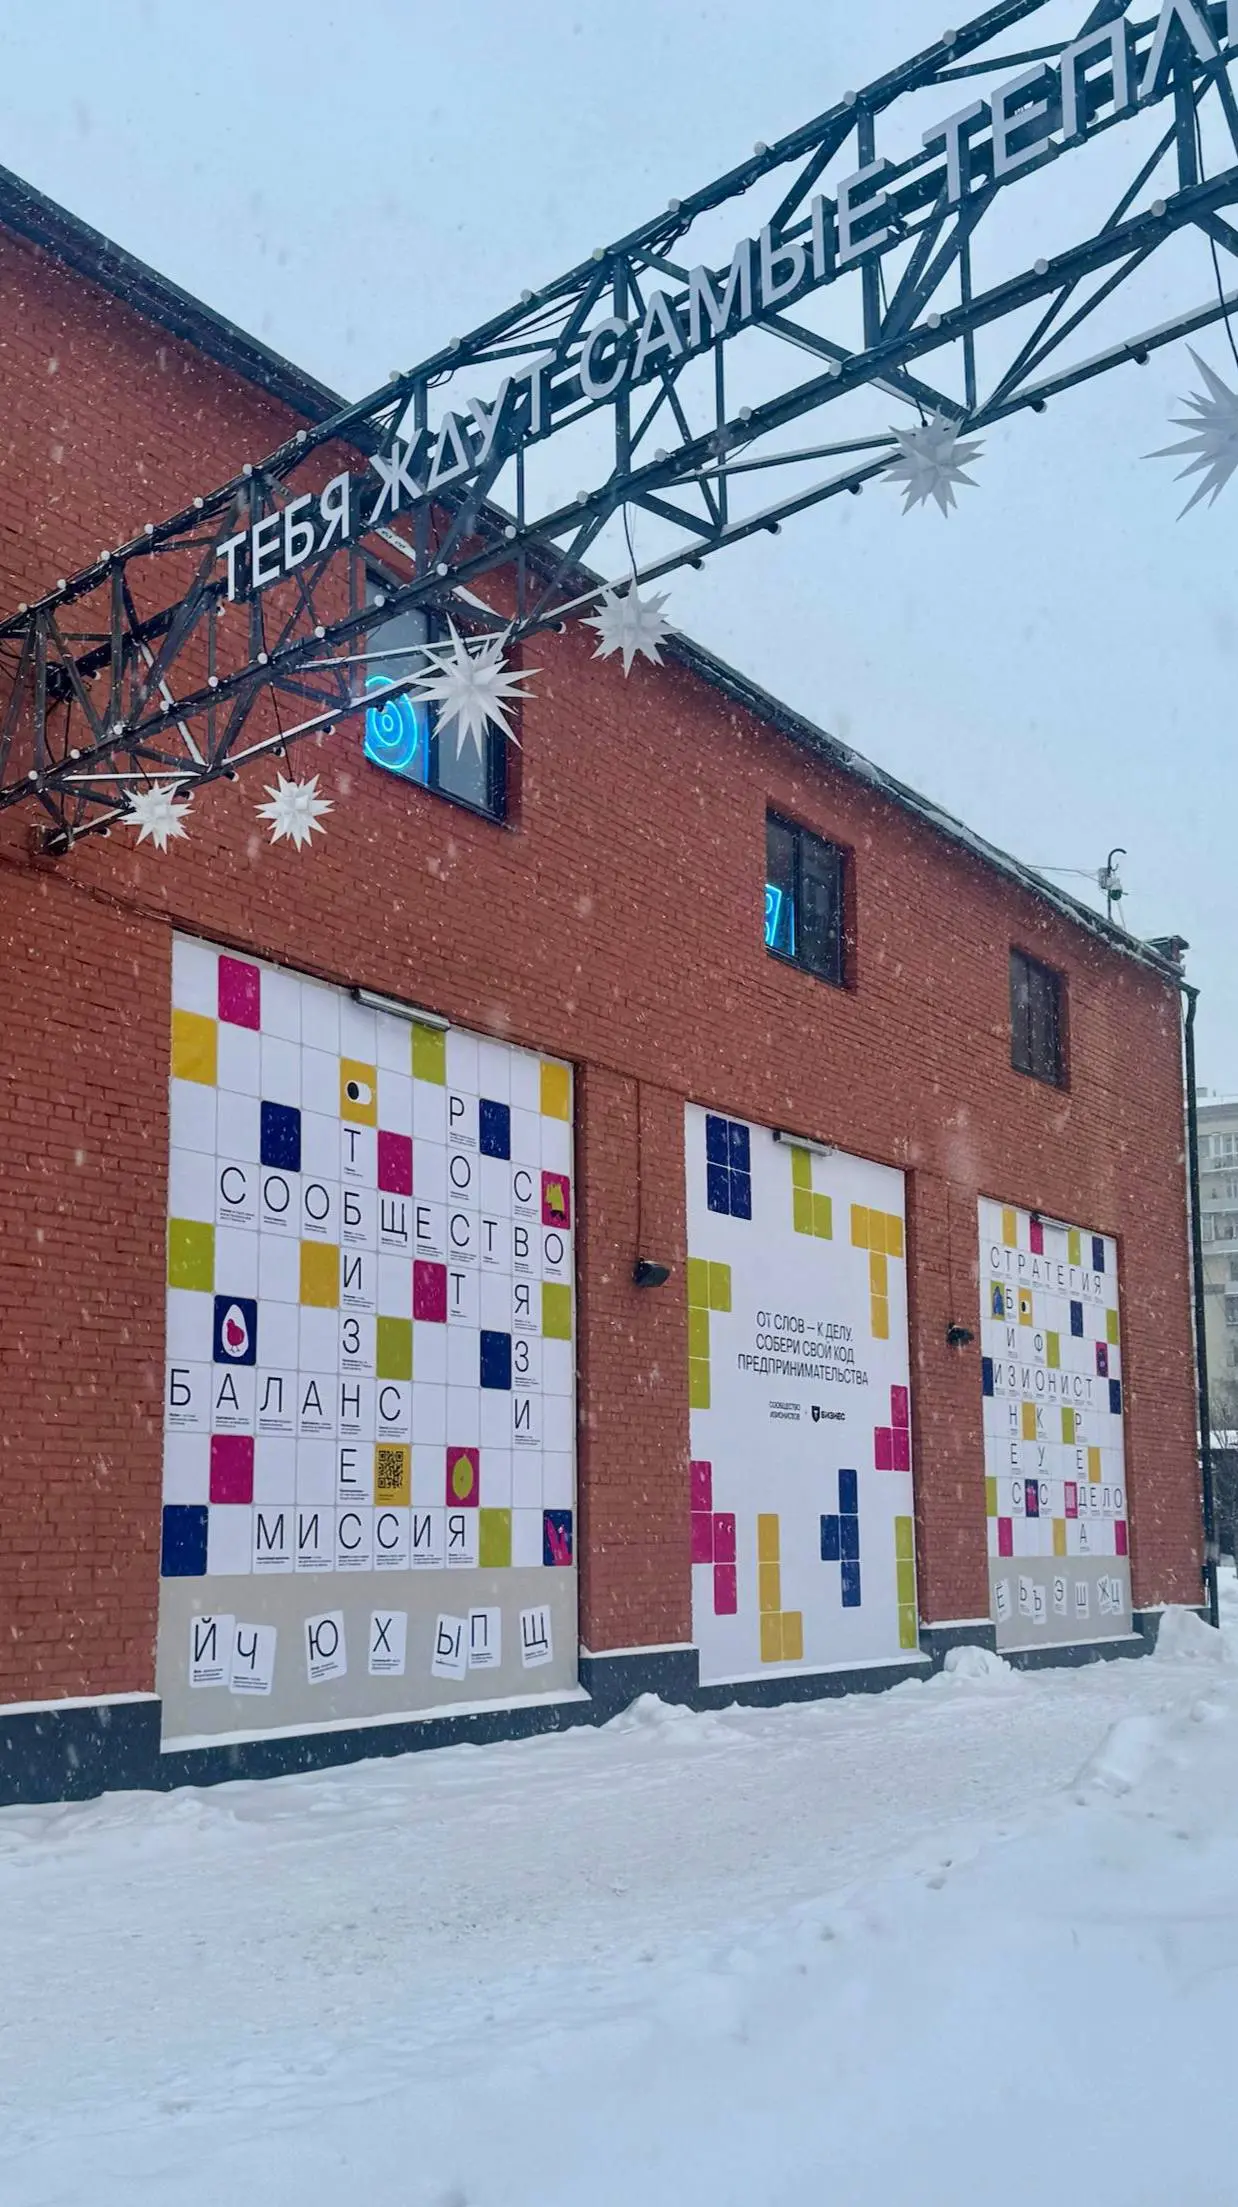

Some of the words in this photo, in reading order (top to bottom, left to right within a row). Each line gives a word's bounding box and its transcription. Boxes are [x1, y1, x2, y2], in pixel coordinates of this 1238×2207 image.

[216, 471, 350, 602] ТЕБЯ
[367, 349, 557, 526] ЖДУТ
[579, 157, 894, 401] САМЫЕ
[922, 0, 1238, 204] ТЕПЛ
[220, 1166, 564, 1265] СООБЩЕСТВО
[990, 1246, 1102, 1295] СТРАТЕГИЯ
[756, 1311, 771, 1328] ОТ
[774, 1314, 805, 1333] СЛОВ
[817, 1322, 824, 1336] К
[825, 1323, 853, 1342] ДЕЛУ.
[738, 1353, 869, 1385] ПРЕДПРИНИМАТЕЛЬСТВА
[756, 1333, 800, 1354] СОБЕРИ
[802, 1340, 832, 1360] СВОЙ
[834, 1346, 855, 1364] КОД
[170, 1369, 401, 1421] БАЛАНС
[1078, 1486, 1123, 1508] ДЕЛО
[256, 1513, 465, 1550] МИССИЯ
[194, 1617, 217, 1662] Й
[237, 1631, 258, 1670] Ч
[308, 1619, 339, 1660] Ю
[373, 1617, 392, 1652] Х
[436, 1620, 462, 1658] Ы
[471, 1614, 487, 1648] П
[522, 1612, 548, 1649] Щ
